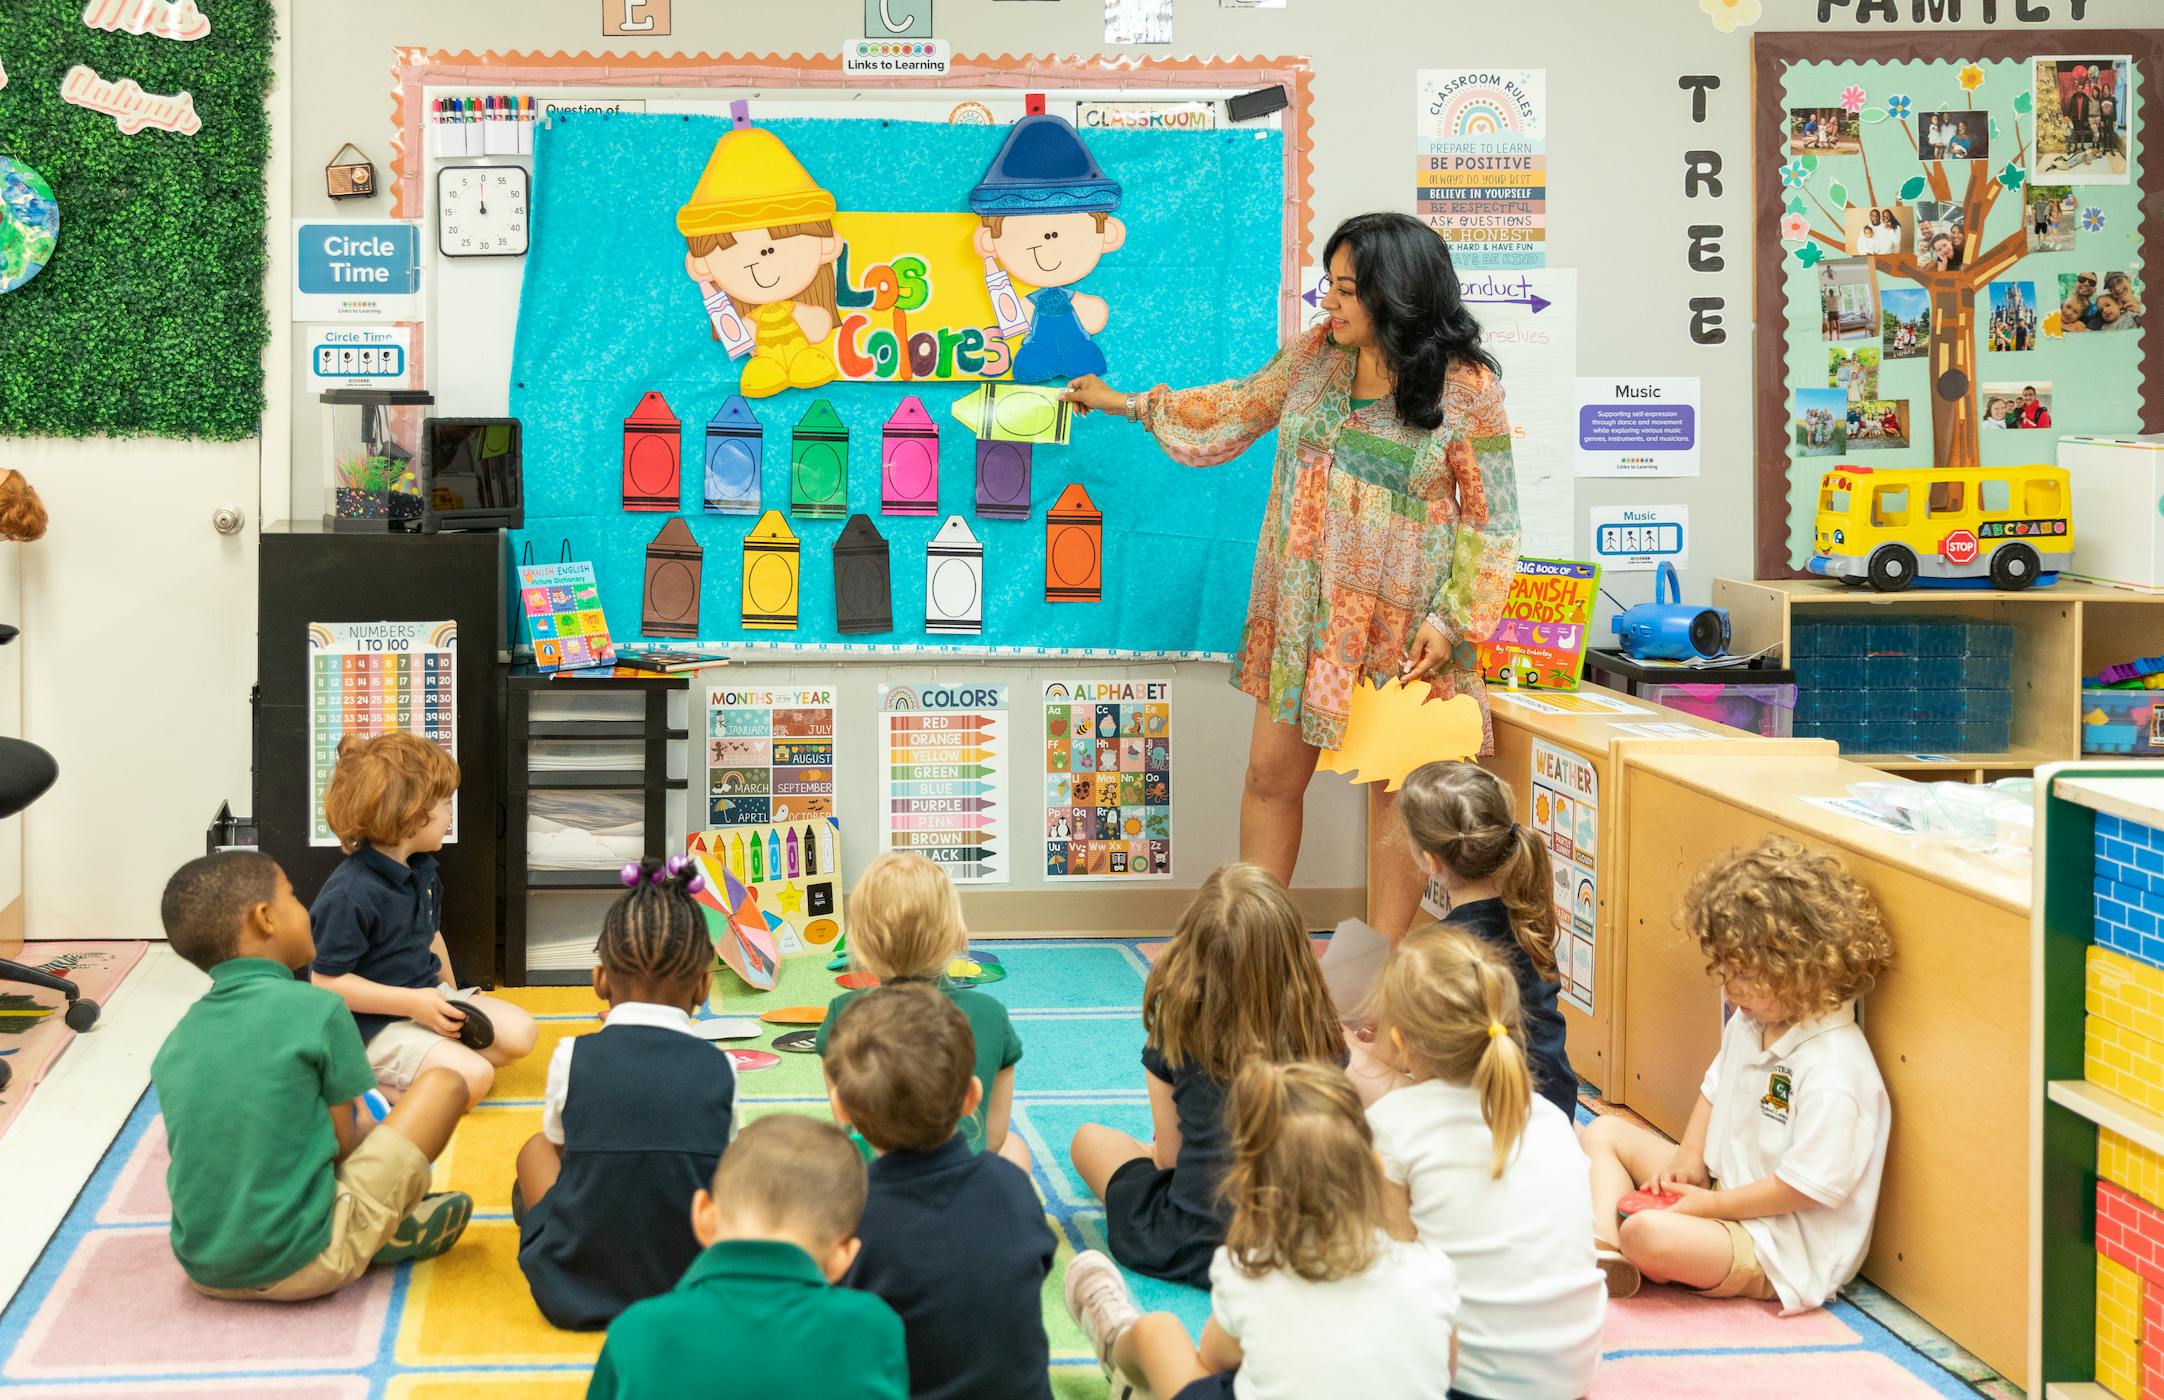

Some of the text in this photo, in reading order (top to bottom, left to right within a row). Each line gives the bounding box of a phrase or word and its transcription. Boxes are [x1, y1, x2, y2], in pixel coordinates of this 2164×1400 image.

[848, 59, 944, 72] Links to Learning
[1430, 73, 1533, 118] CLASSROOM RULES
[546, 104, 620, 114] Question of
[1086, 110, 1206, 127] CLASSROOM
[1430, 143, 1532, 154] PREPARE TO LEARN
[1431, 157, 1531, 170] BE POSITIVE
[498, 177, 507, 185] 55
[1467, 175, 1479, 184] DO
[1430, 189, 1532, 199] BELIEVE IN YOURSELF
[444, 208, 453, 216] 15
[1431, 202, 1532, 214] BE RESPECTFUL
[1430, 216, 1532, 227] ASK QUESTIONS
[448, 226, 458, 234] 20
[1435, 229, 1533, 241] E HONEST
[324, 236, 395, 257] Circle
[461, 239, 471, 247] 25
[479, 242, 489, 250] 30
[498, 238, 507, 246] 35
[1483, 254, 1500, 265] BE
[1503, 254, 1538, 265] KIND
[330, 262, 390, 282] Time
[836, 241, 929, 311] Los
[1460, 274, 1533, 298] onduct
[325, 332, 360, 342] Circle
[1482, 320, 1550, 344] urselves
[838, 306, 1013, 381] Colores
[1615, 385, 1661, 398] Music
[1597, 410, 1678, 418] Supporting self-expression
[1610, 427, 1640, 435] exploring
[1624, 511, 1656, 521] Music
[1949, 542, 1973, 552] STOP
[557, 565, 590, 575] ENGLISH
[1516, 561, 1571, 575] BIG BOOK OF
[1508, 577, 1578, 606] PANISH
[349, 625, 415, 638] NUMBERS
[365, 640, 383, 651] TO
[387, 639, 409, 650] 100
[440, 658, 450, 667] 10
[399, 676, 451, 685] 17 19 20
[1074, 683, 1167, 700] ALPHABET
[357, 694, 451, 704] 24 27 29 30
[711, 692, 773, 705] MONTHS
[793, 691, 830, 704] YEAR
[922, 689, 999, 708] COLORS
[1048, 705, 1157, 715] Aa Cc Ee
[425, 712, 451, 721] 39 40
[922, 716, 949, 729] RED
[726, 725, 769, 735] JANUARY
[808, 724, 832, 735] JULY
[910, 733, 962, 746] ORANGE
[1048, 740, 1059, 749] Ff
[1072, 740, 1085, 750] Gg
[1096, 740, 1109, 748] Hh
[792, 754, 832, 764] AUGUST
[912, 750, 960, 762] YELLOW
[914, 766, 959, 779] GREEN
[1536, 749, 1592, 795] WEATHER
[1096, 774, 1160, 782] Mm Nn Oo
[734, 783, 769, 793] MARCH
[777, 783, 832, 793] SEPTEMBER
[920, 783, 953, 795] BLUE
[911, 800, 962, 812] PURPLE
[737, 813, 769, 823] APRIL
[788, 812, 832, 821] OCTOBER
[1048, 808, 1108, 819] Pp Qq Rr
[919, 816, 955, 828] PINK
[911, 832, 962, 845] BROWN
[1048, 841, 1162, 851] Uu Ww Xx Zz
